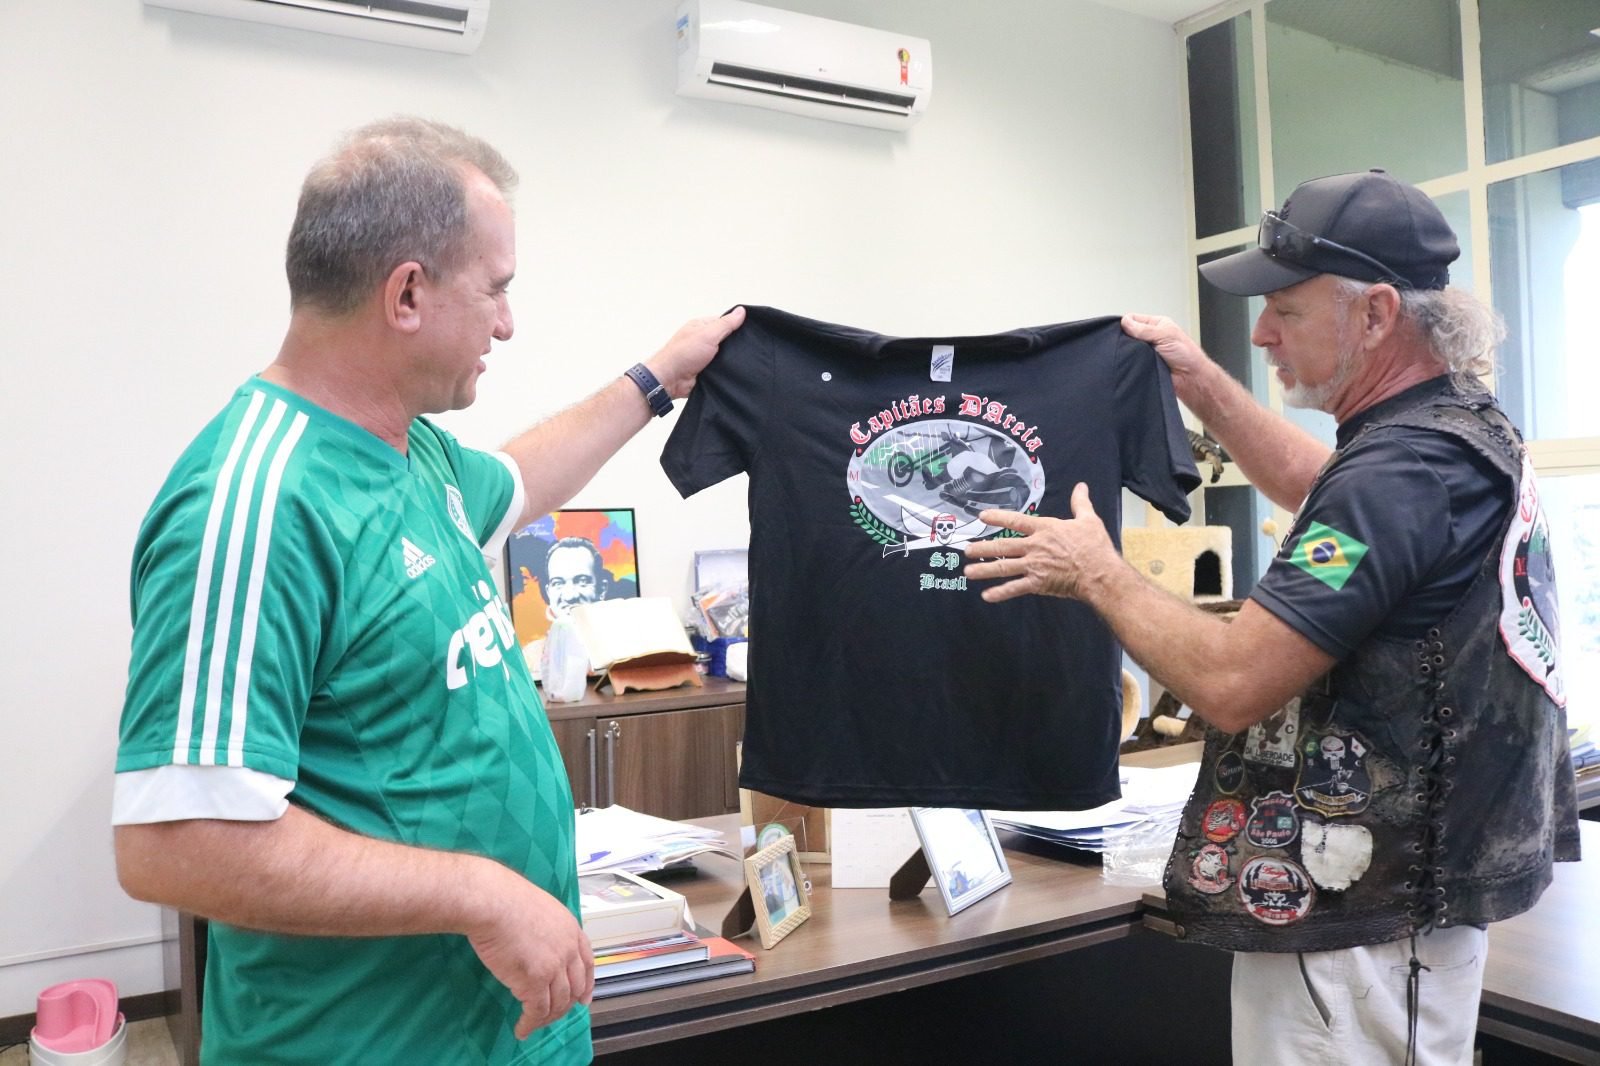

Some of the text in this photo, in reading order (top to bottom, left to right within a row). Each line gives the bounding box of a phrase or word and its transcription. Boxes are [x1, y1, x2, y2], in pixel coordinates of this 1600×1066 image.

[850, 393, 1044, 452] Capitães D'Areia
[849, 470, 859, 481] M
[407, 554, 436, 579] adidas
[929, 552, 960, 570] SP
[920, 574, 968, 591] Brasil
[1256, 748, 1294, 763] LIBERDADE
[1266, 829, 1291, 837] Paulo
